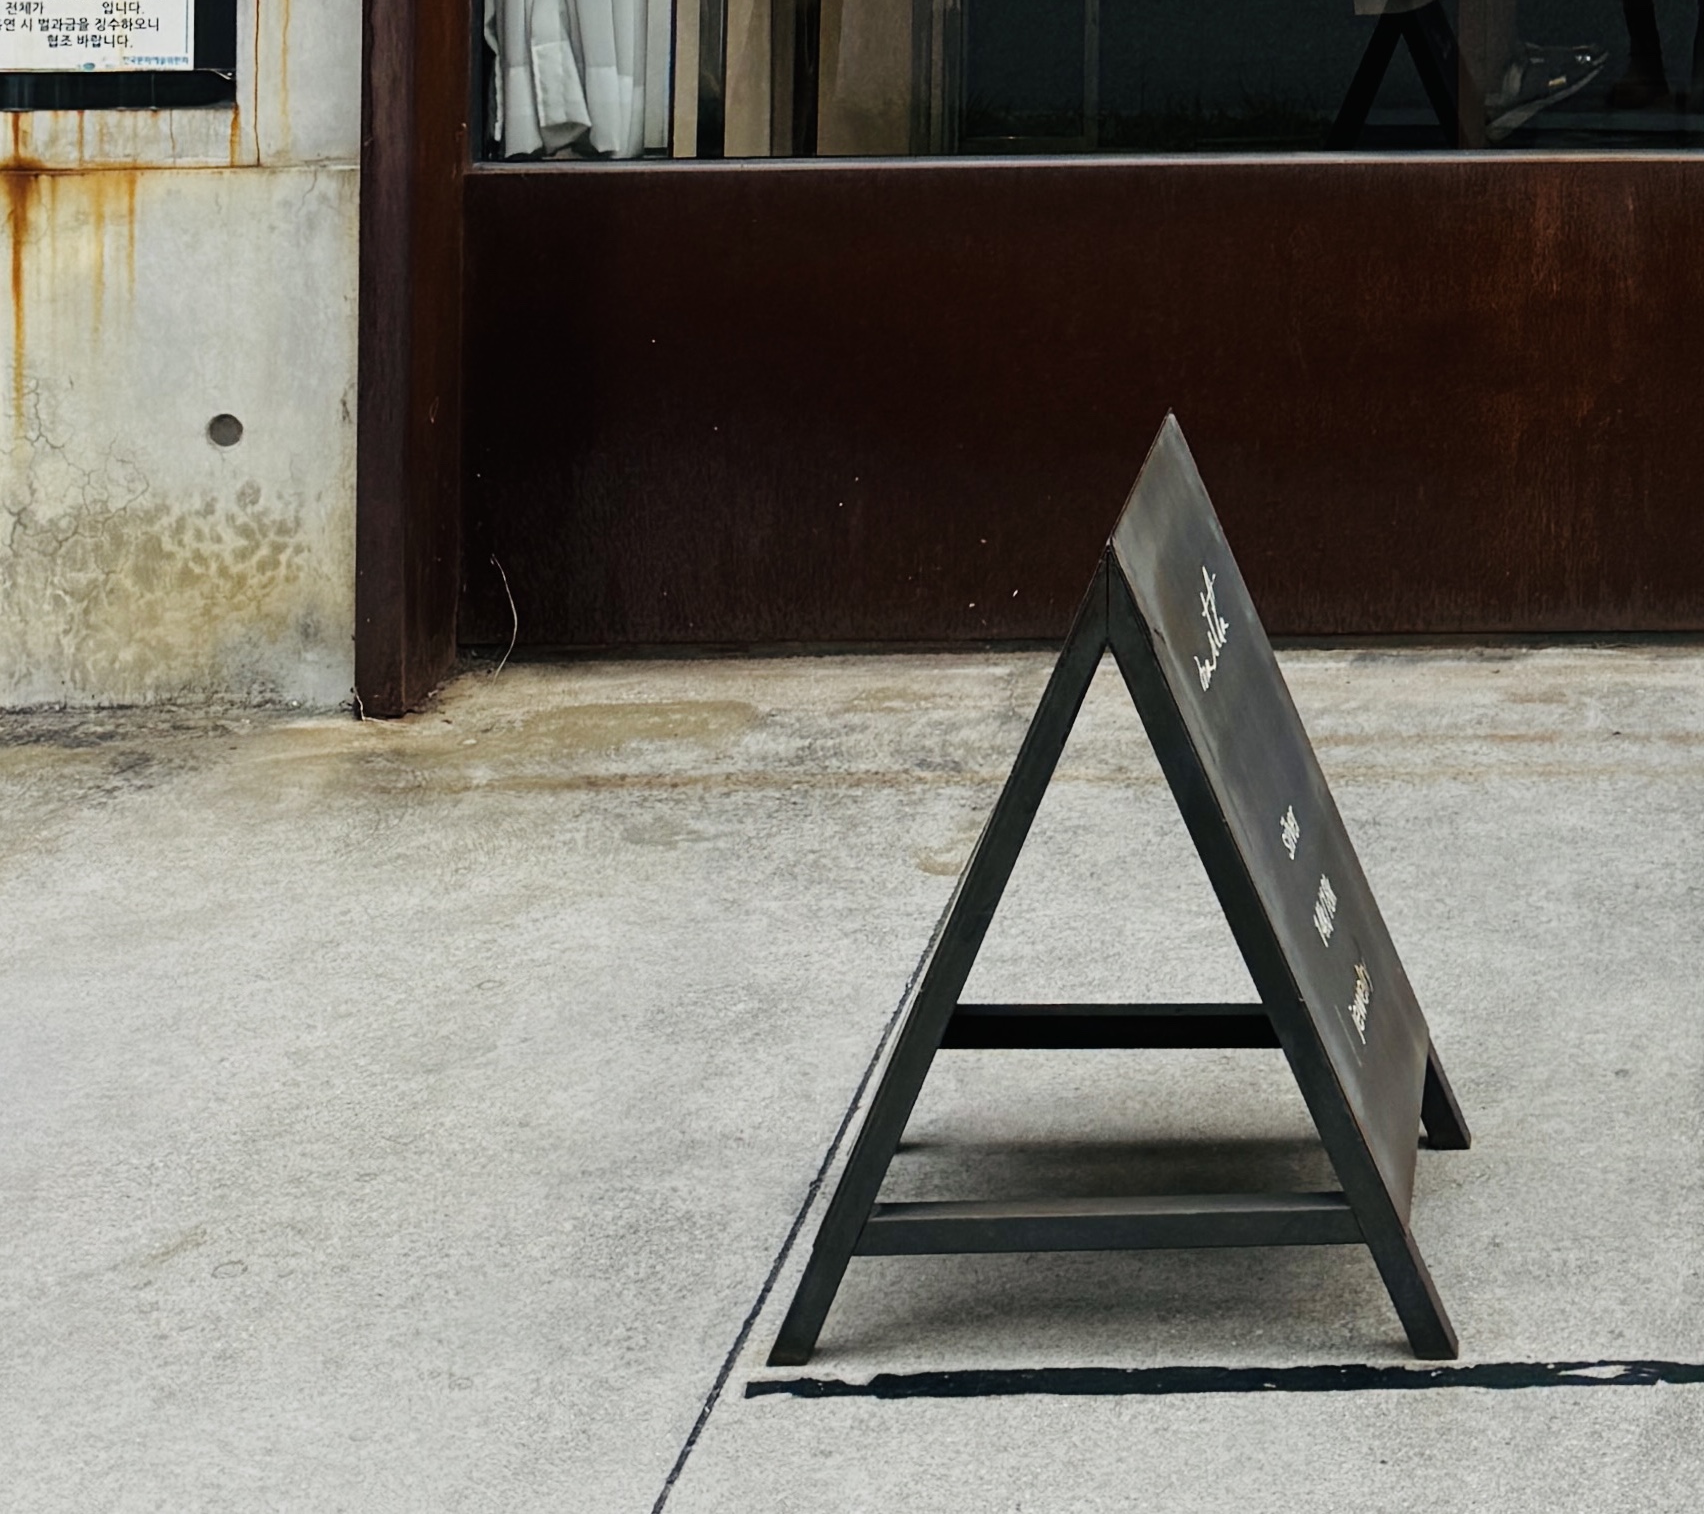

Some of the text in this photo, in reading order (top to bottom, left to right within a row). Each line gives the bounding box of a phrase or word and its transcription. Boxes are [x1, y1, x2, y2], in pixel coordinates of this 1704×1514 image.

[102, 1, 145, 15] 입니다.
[0, 17, 16, 32] 연
[20, 17, 33, 32] 시
[95, 17, 159, 32] 징수하오니
[77, 34, 133, 49] 바랍니다.
